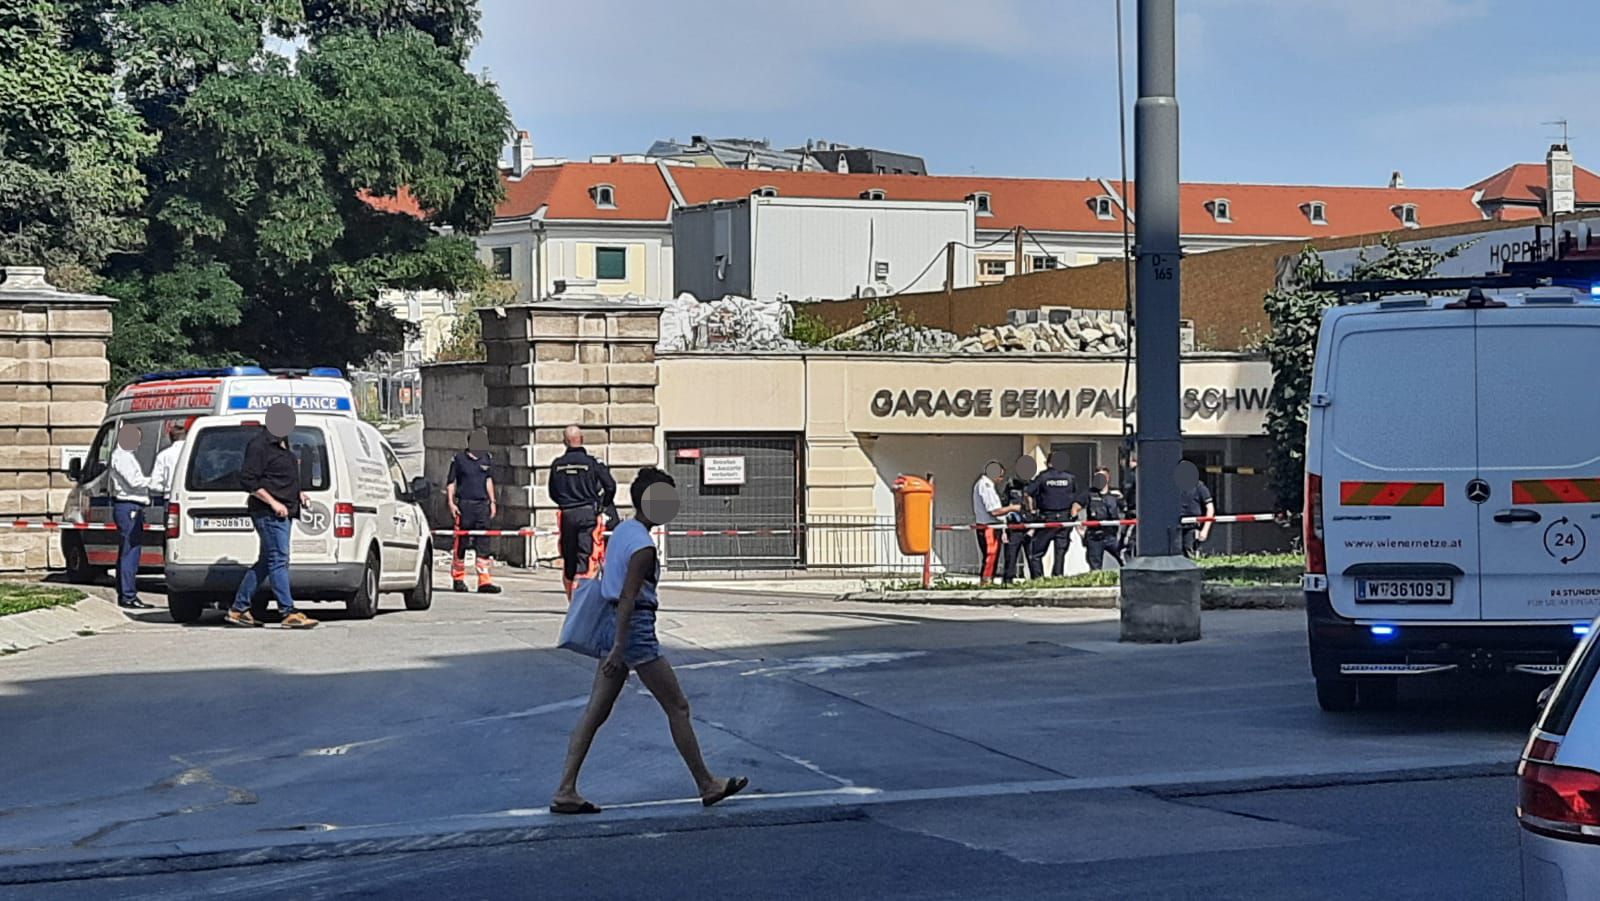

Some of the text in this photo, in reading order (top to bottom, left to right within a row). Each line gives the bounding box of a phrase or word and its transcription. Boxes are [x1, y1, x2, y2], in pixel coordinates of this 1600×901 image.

[1490, 241, 1541, 265] HOPP
[1155, 268, 1172, 280] 165
[871, 389, 993, 417] GARAGE
[1000, 389, 1070, 418] BEIM
[1077, 388, 1137, 417] PAL
[1344, 539, 1462, 548] www.wienernetze.at
[1555, 533, 1575, 546] 24
